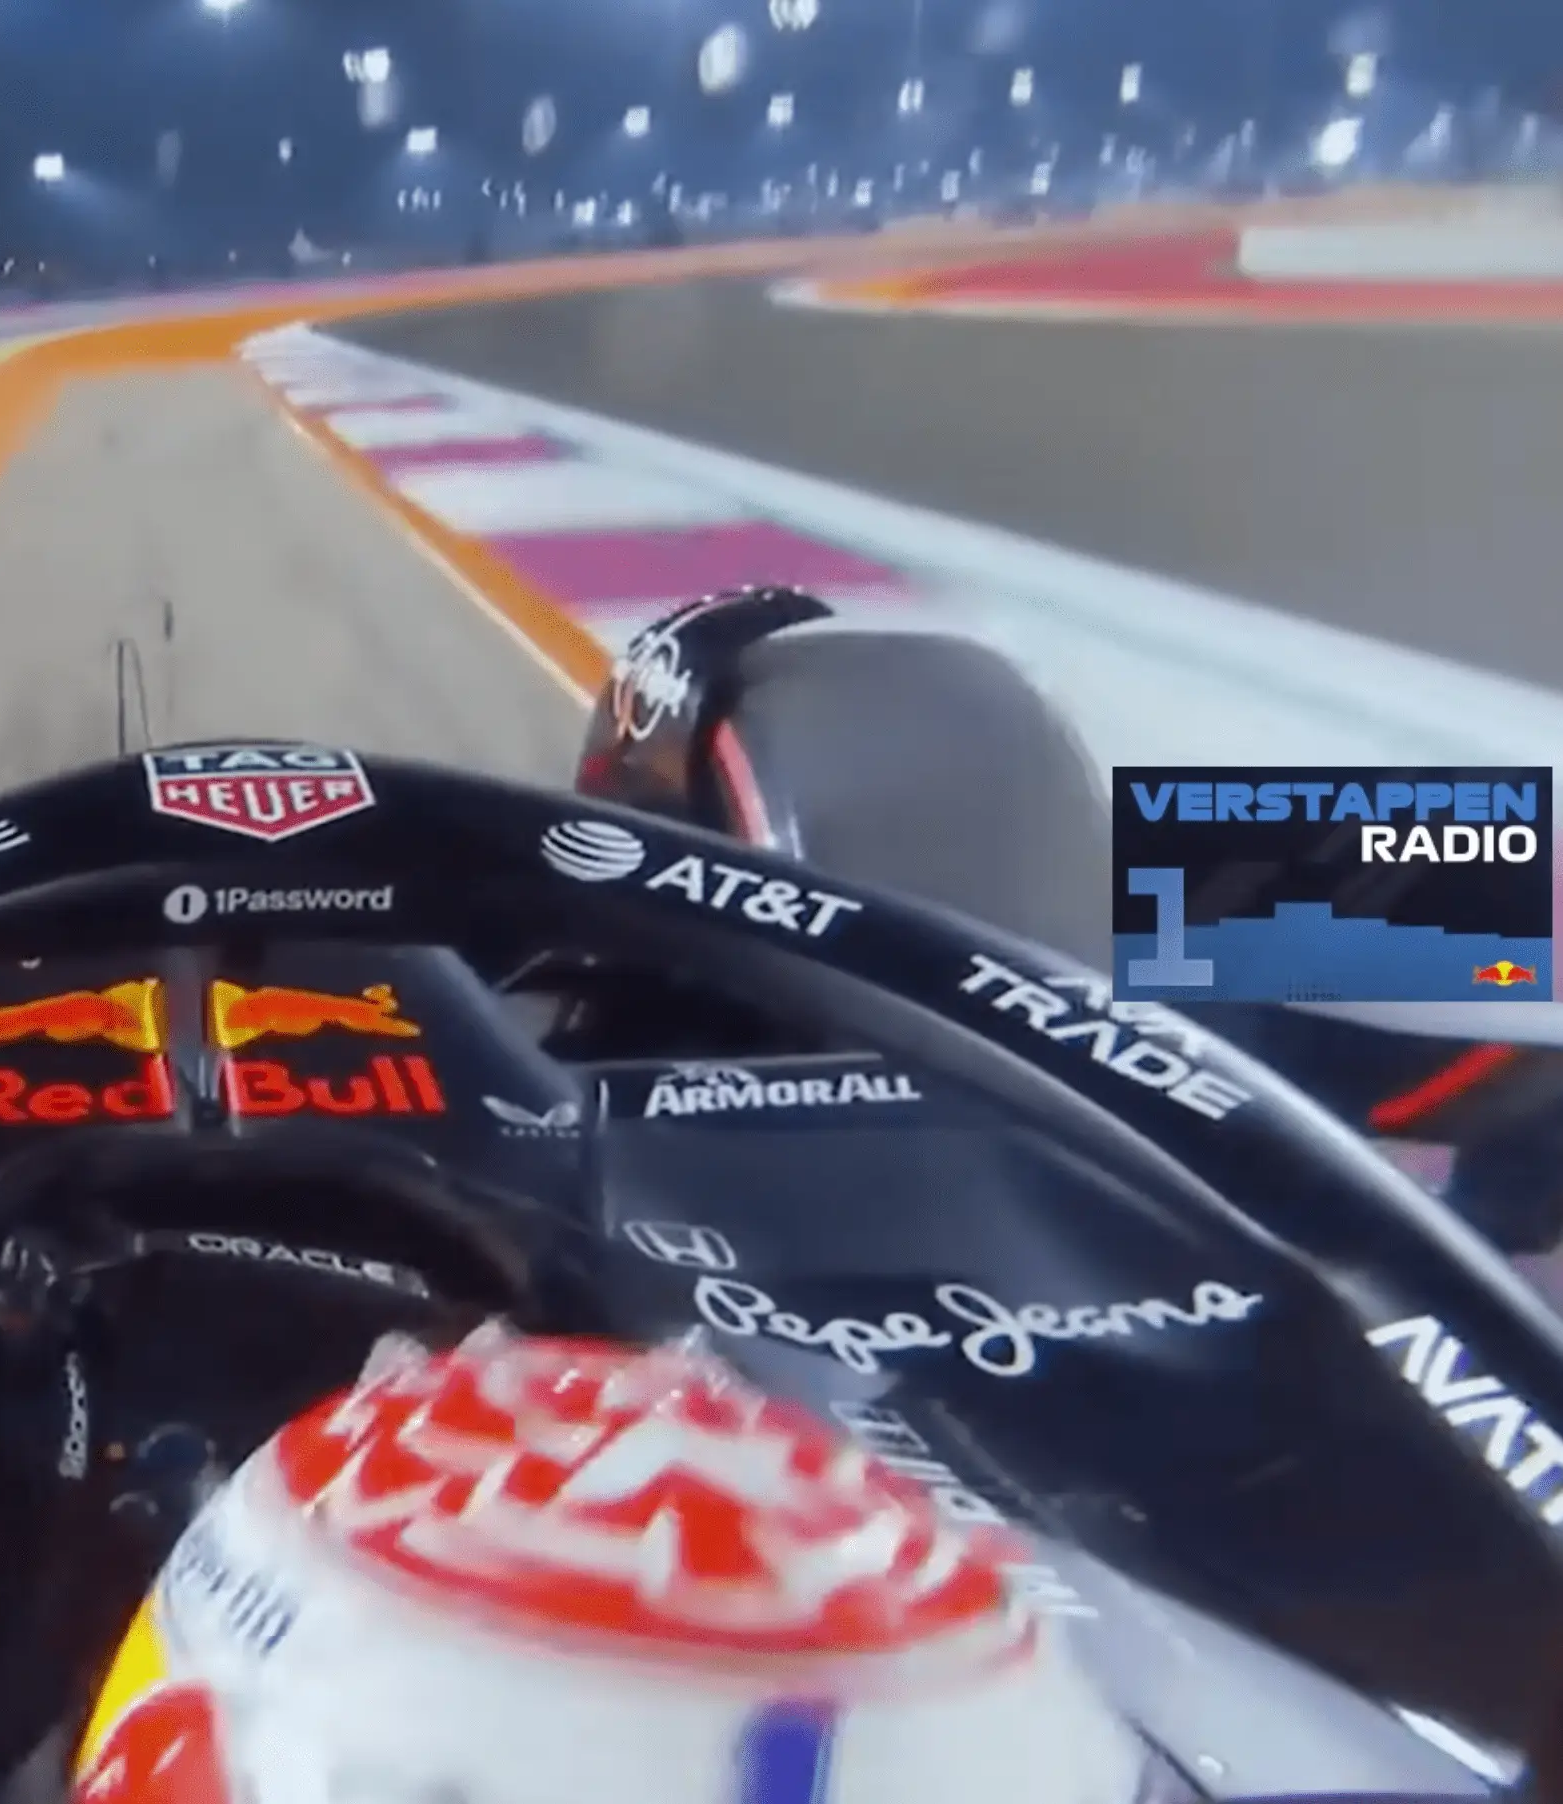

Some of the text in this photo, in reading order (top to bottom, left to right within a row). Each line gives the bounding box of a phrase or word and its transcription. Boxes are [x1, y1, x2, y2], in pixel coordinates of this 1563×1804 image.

[163, 750, 338, 770] TAG
[165, 779, 355, 823] HEUER
[214, 885, 394, 914] 1Password
[644, 855, 863, 937] AT&T
[959, 954, 1252, 1121] TRADE
[220, 1053, 446, 1119] Bull
[187, 1231, 397, 1284] ORACLE
[694, 1274, 1263, 1376] Pepe Jeans
[1363, 1313, 1563, 1527] AVAT
